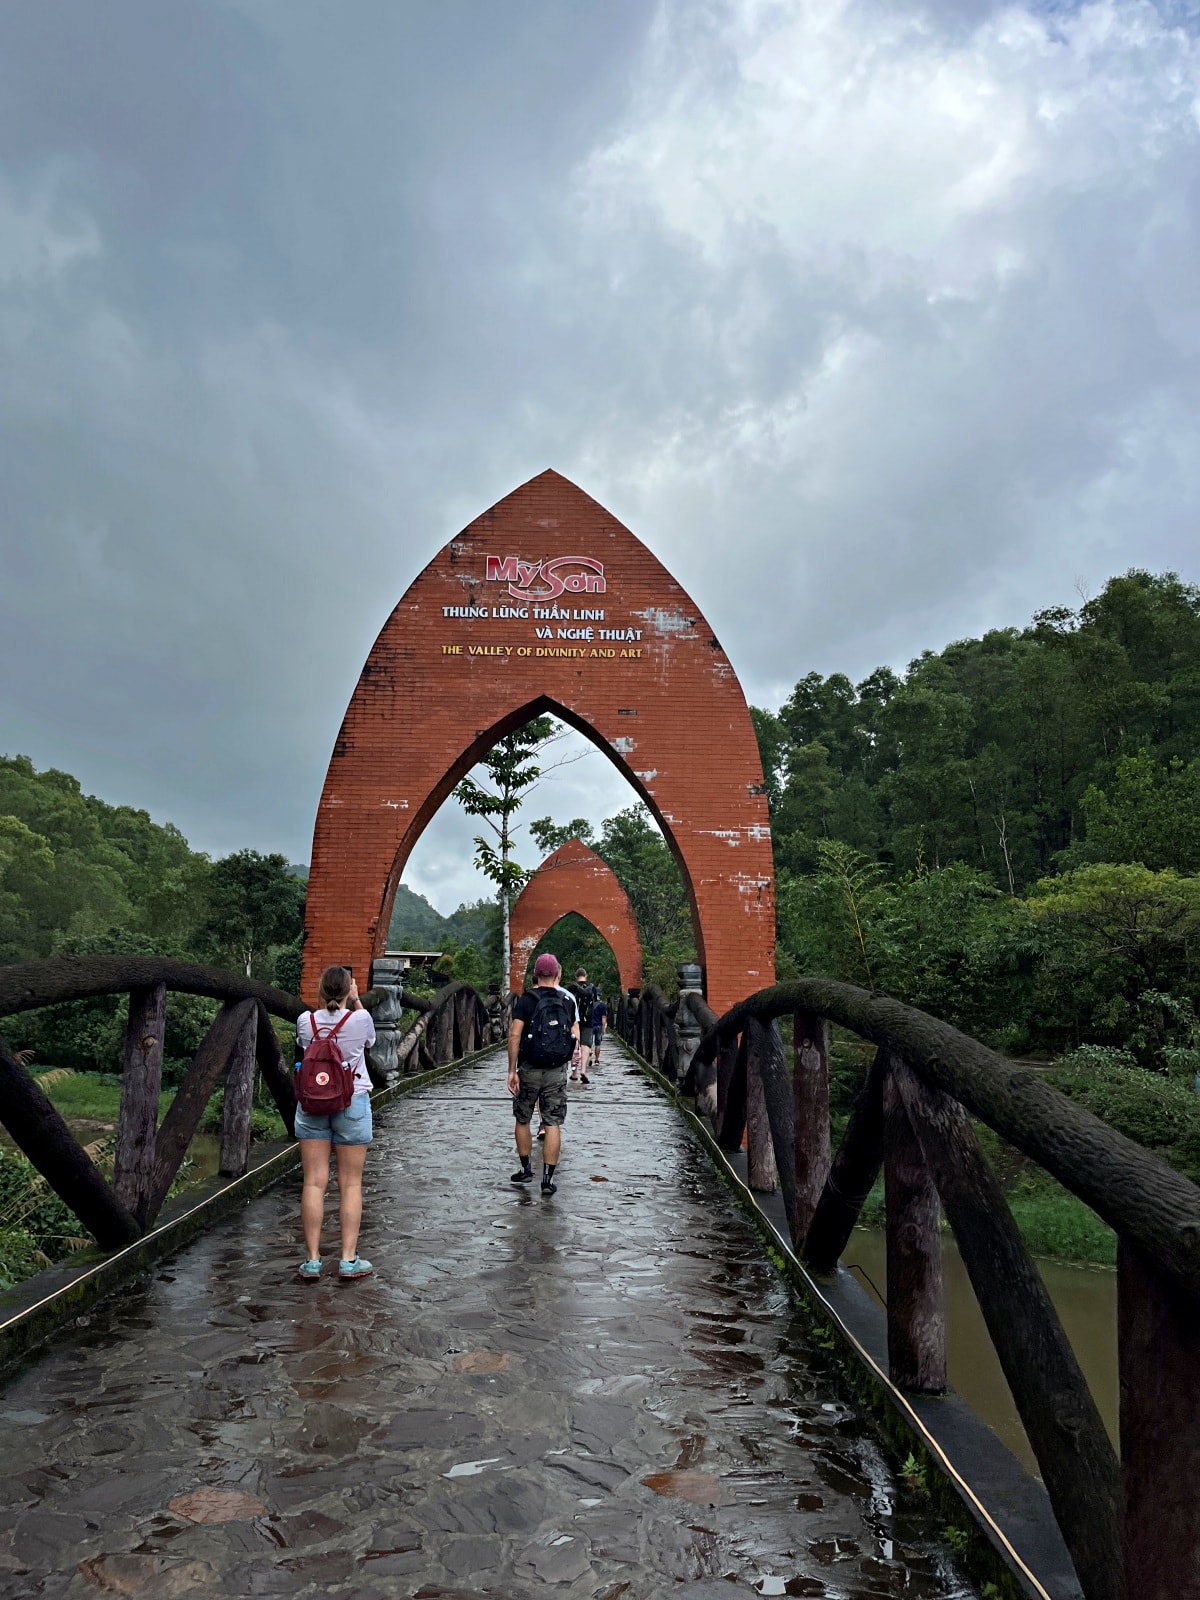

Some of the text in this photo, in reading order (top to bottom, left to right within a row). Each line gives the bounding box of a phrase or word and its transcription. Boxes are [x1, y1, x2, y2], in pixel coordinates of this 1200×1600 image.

[442, 607, 488, 618] THUNG
[492, 605, 528, 618] LŨNG
[574, 609, 604, 620] LINH
[535, 625, 642, 643] VÀ NGHỆ THUẬT
[442, 646, 642, 658] THE VALLEY OF DIVINITY AND ART
